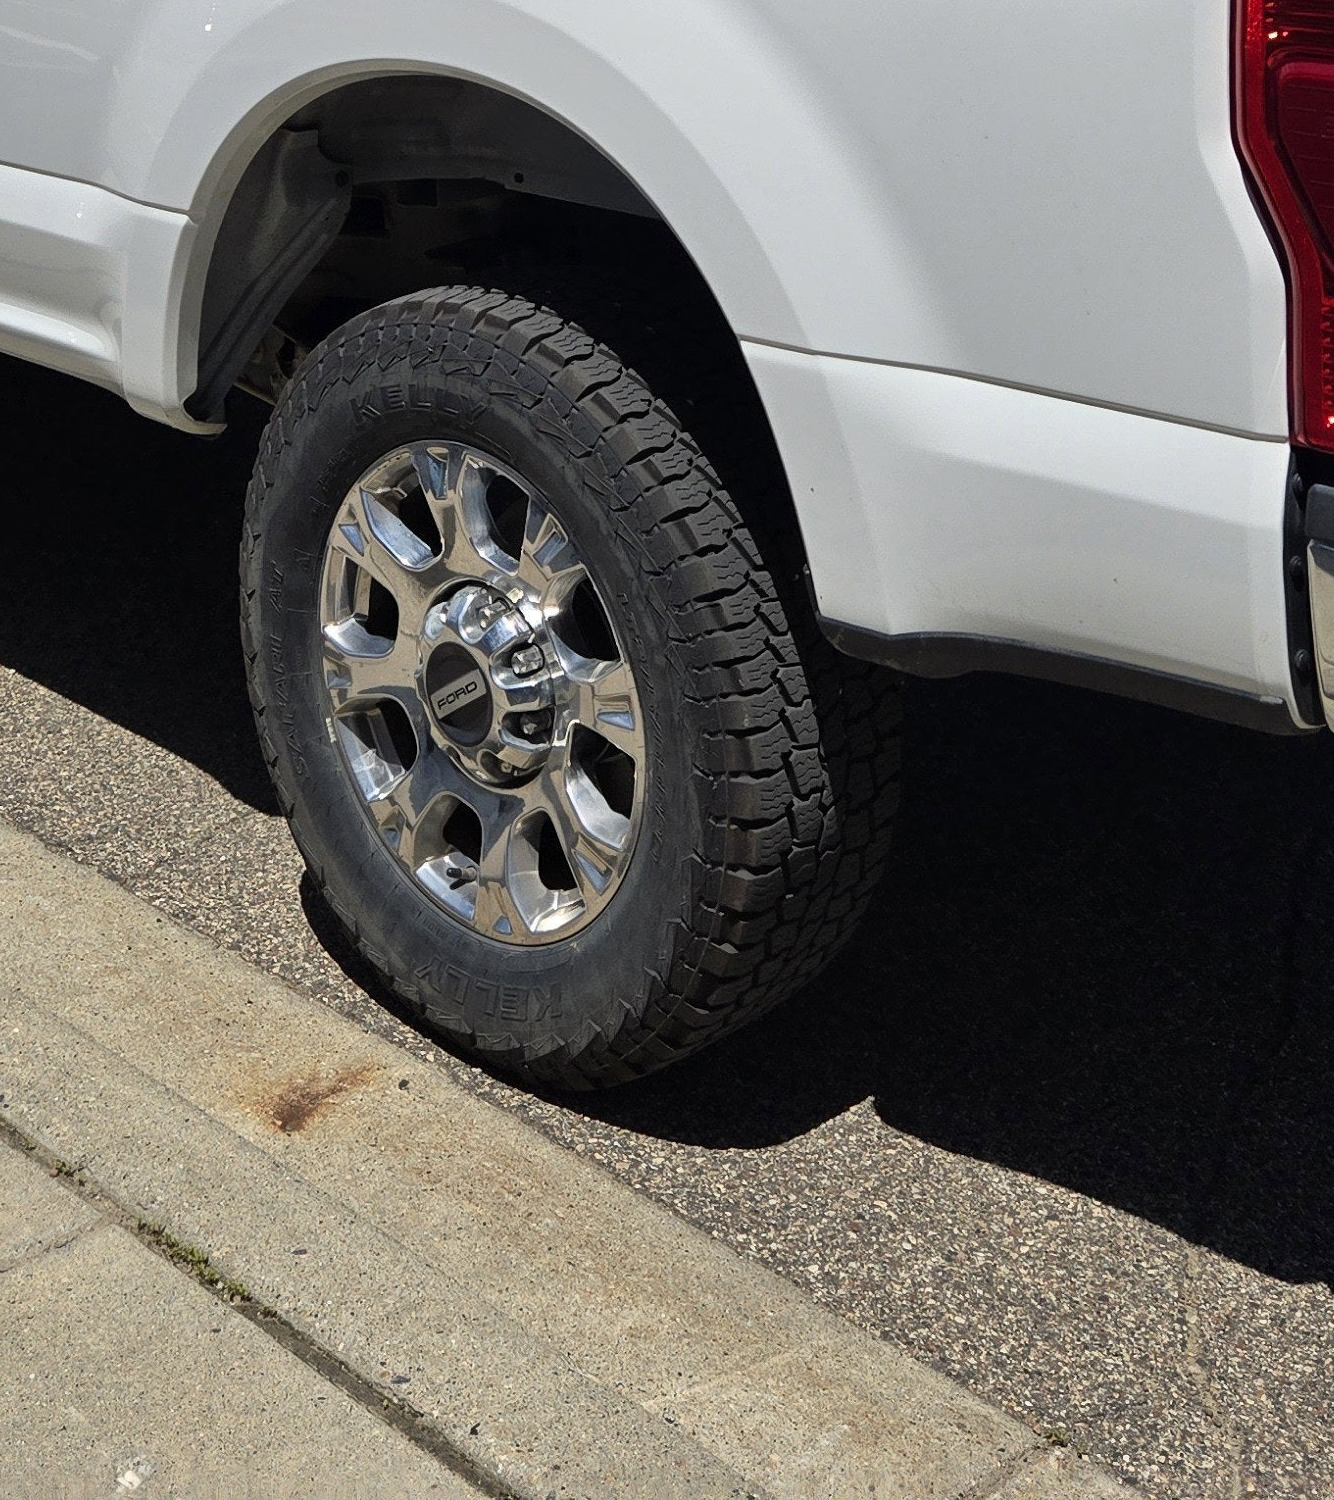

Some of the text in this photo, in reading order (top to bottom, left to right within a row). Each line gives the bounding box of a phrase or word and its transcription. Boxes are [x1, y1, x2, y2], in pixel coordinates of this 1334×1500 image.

[349, 384, 489, 426] KELLY
[437, 681, 478, 710] FORD
[414, 956, 564, 1022] KELLY
